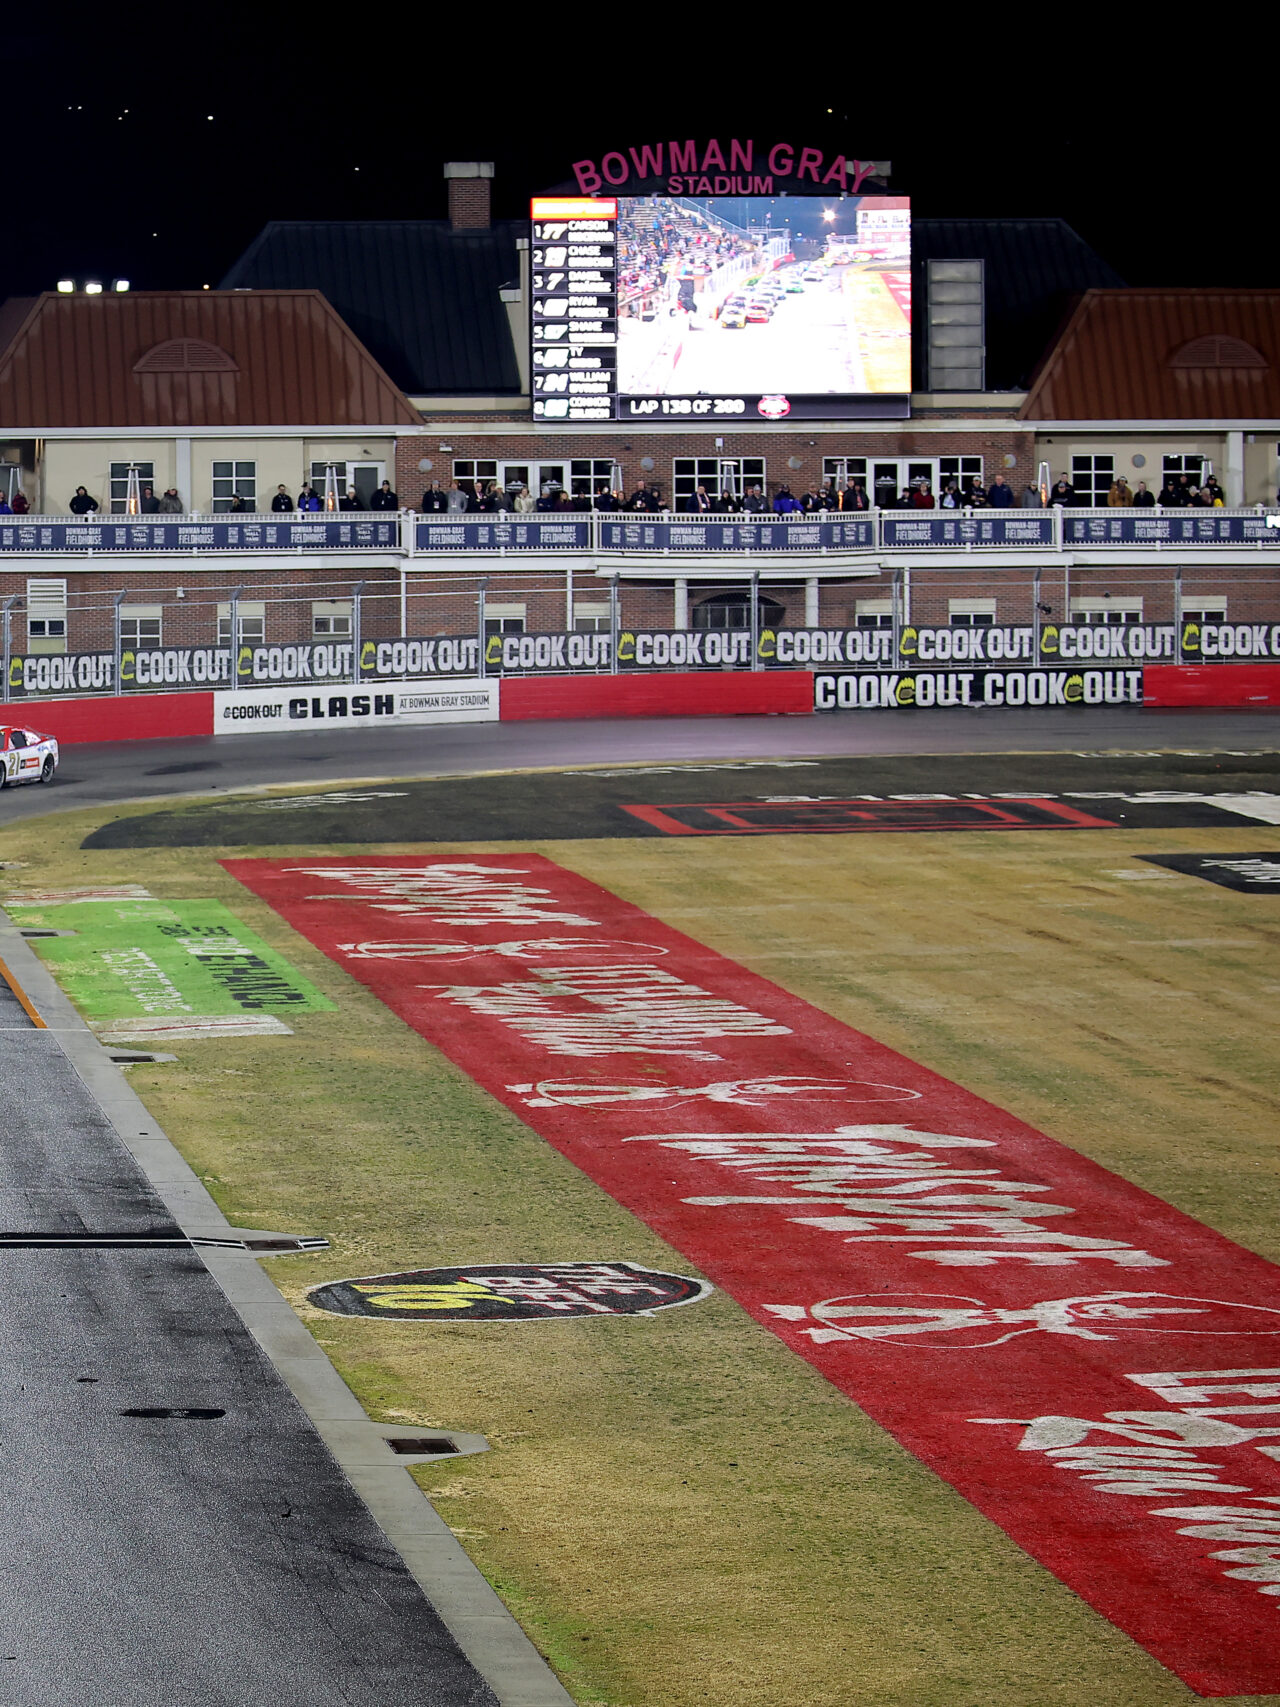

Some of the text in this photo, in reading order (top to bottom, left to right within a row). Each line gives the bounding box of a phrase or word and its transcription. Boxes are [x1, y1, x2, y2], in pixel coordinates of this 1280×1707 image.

[572, 139, 875, 194] BOWMAN GRAY
[668, 176, 773, 194] STADIUM
[535, 225, 541, 237] 1
[542, 223, 568, 240] 77
[533, 250, 543, 263] 2
[533, 275, 543, 288] 3
[547, 273, 565, 291] 7
[533, 300, 543, 313] 4
[533, 326, 543, 339] 5
[533, 351, 544, 364] 6
[569, 347, 584, 357] TY
[534, 376, 544, 389] 7
[533, 401, 544, 414] 8
[630, 400, 659, 414] LAP
[693, 400, 712, 414] OF
[713, 399, 746, 414] 200
[66, 535, 102, 545] FIELDHOUSE
[178, 534, 214, 544] FIELDHOUSE
[291, 533, 327, 543] FIELDHOUSE
[429, 534, 466, 544] FIELDHOUSE
[540, 533, 576, 543] FIELDHOUSE
[670, 535, 706, 545] FIELDHOUSE
[788, 534, 820, 544] FIELDHOUSE
[896, 531, 931, 540] FIELDHOUSE
[1005, 529, 1040, 539] FIELDHOUSE
[1135, 528, 1170, 537] FIELDHOUSE
[636, 631, 751, 665] COOK OUT
[777, 629, 892, 662] COOK OUT
[920, 627, 1033, 660] COOK OUT
[1059, 627, 1176, 658] COOK OUT
[1200, 627, 1268, 657] COOK
[376, 638, 478, 674] COOK OUT
[502, 635, 611, 668] COOK OUT
[135, 649, 231, 684] COOK OUT
[252, 644, 354, 679] COOK OUT
[23, 655, 114, 690] COOK OUT
[815, 670, 1143, 708] COOK OUT COOK OUT
[289, 695, 394, 719] CLASH
[400, 694, 489, 708] AT BOWMAN GRAY STADIUM
[232, 704, 283, 719] COOK OUT
[8, 752, 20, 776] 21
